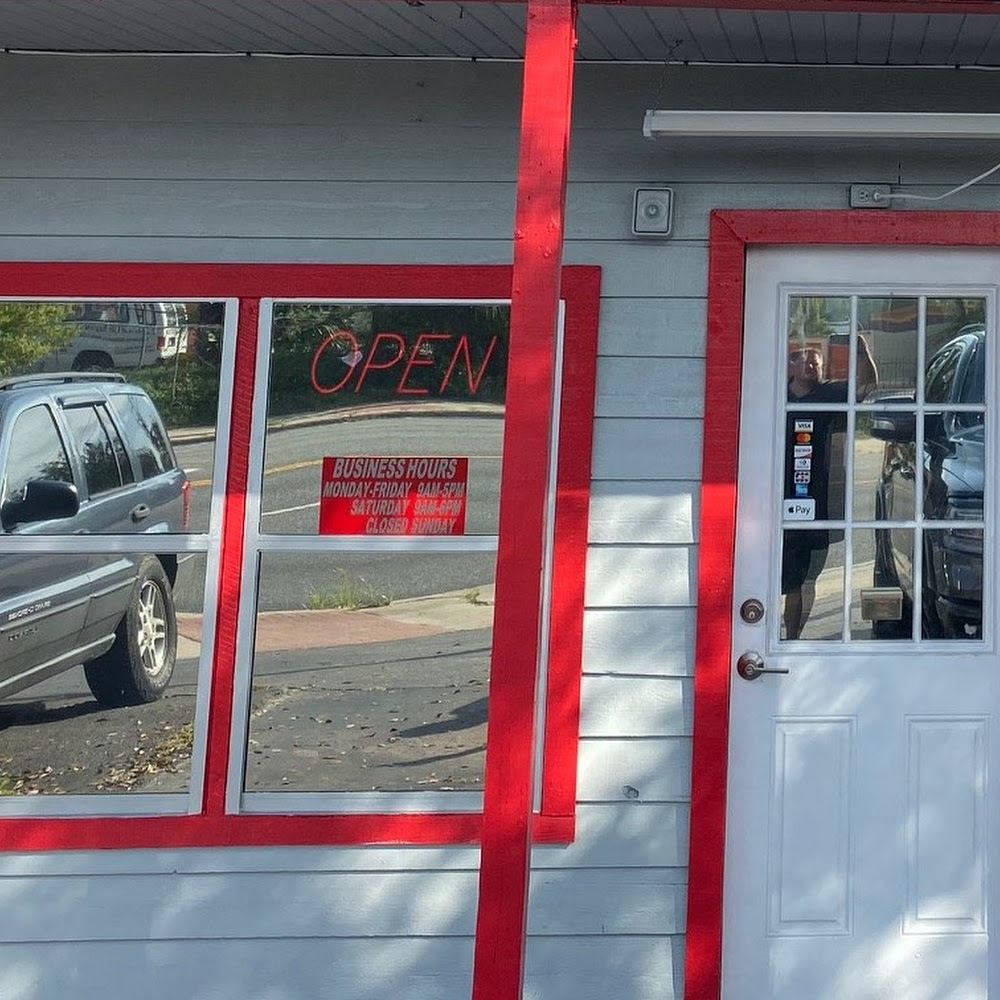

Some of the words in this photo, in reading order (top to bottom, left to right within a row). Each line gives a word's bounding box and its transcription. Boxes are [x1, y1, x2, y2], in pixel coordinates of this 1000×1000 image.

[310, 329, 498, 396] OPEN
[332, 458, 406, 479] BUSINESS
[405, 458, 458, 480] HOURS
[322, 481, 413, 498] MONDAY-FRIDAY
[350, 499, 410, 516] SATURDAY
[795, 505, 811, 516] Pay
[365, 516, 409, 534] CLOSED
[410, 517, 457, 534] SUNDAY
